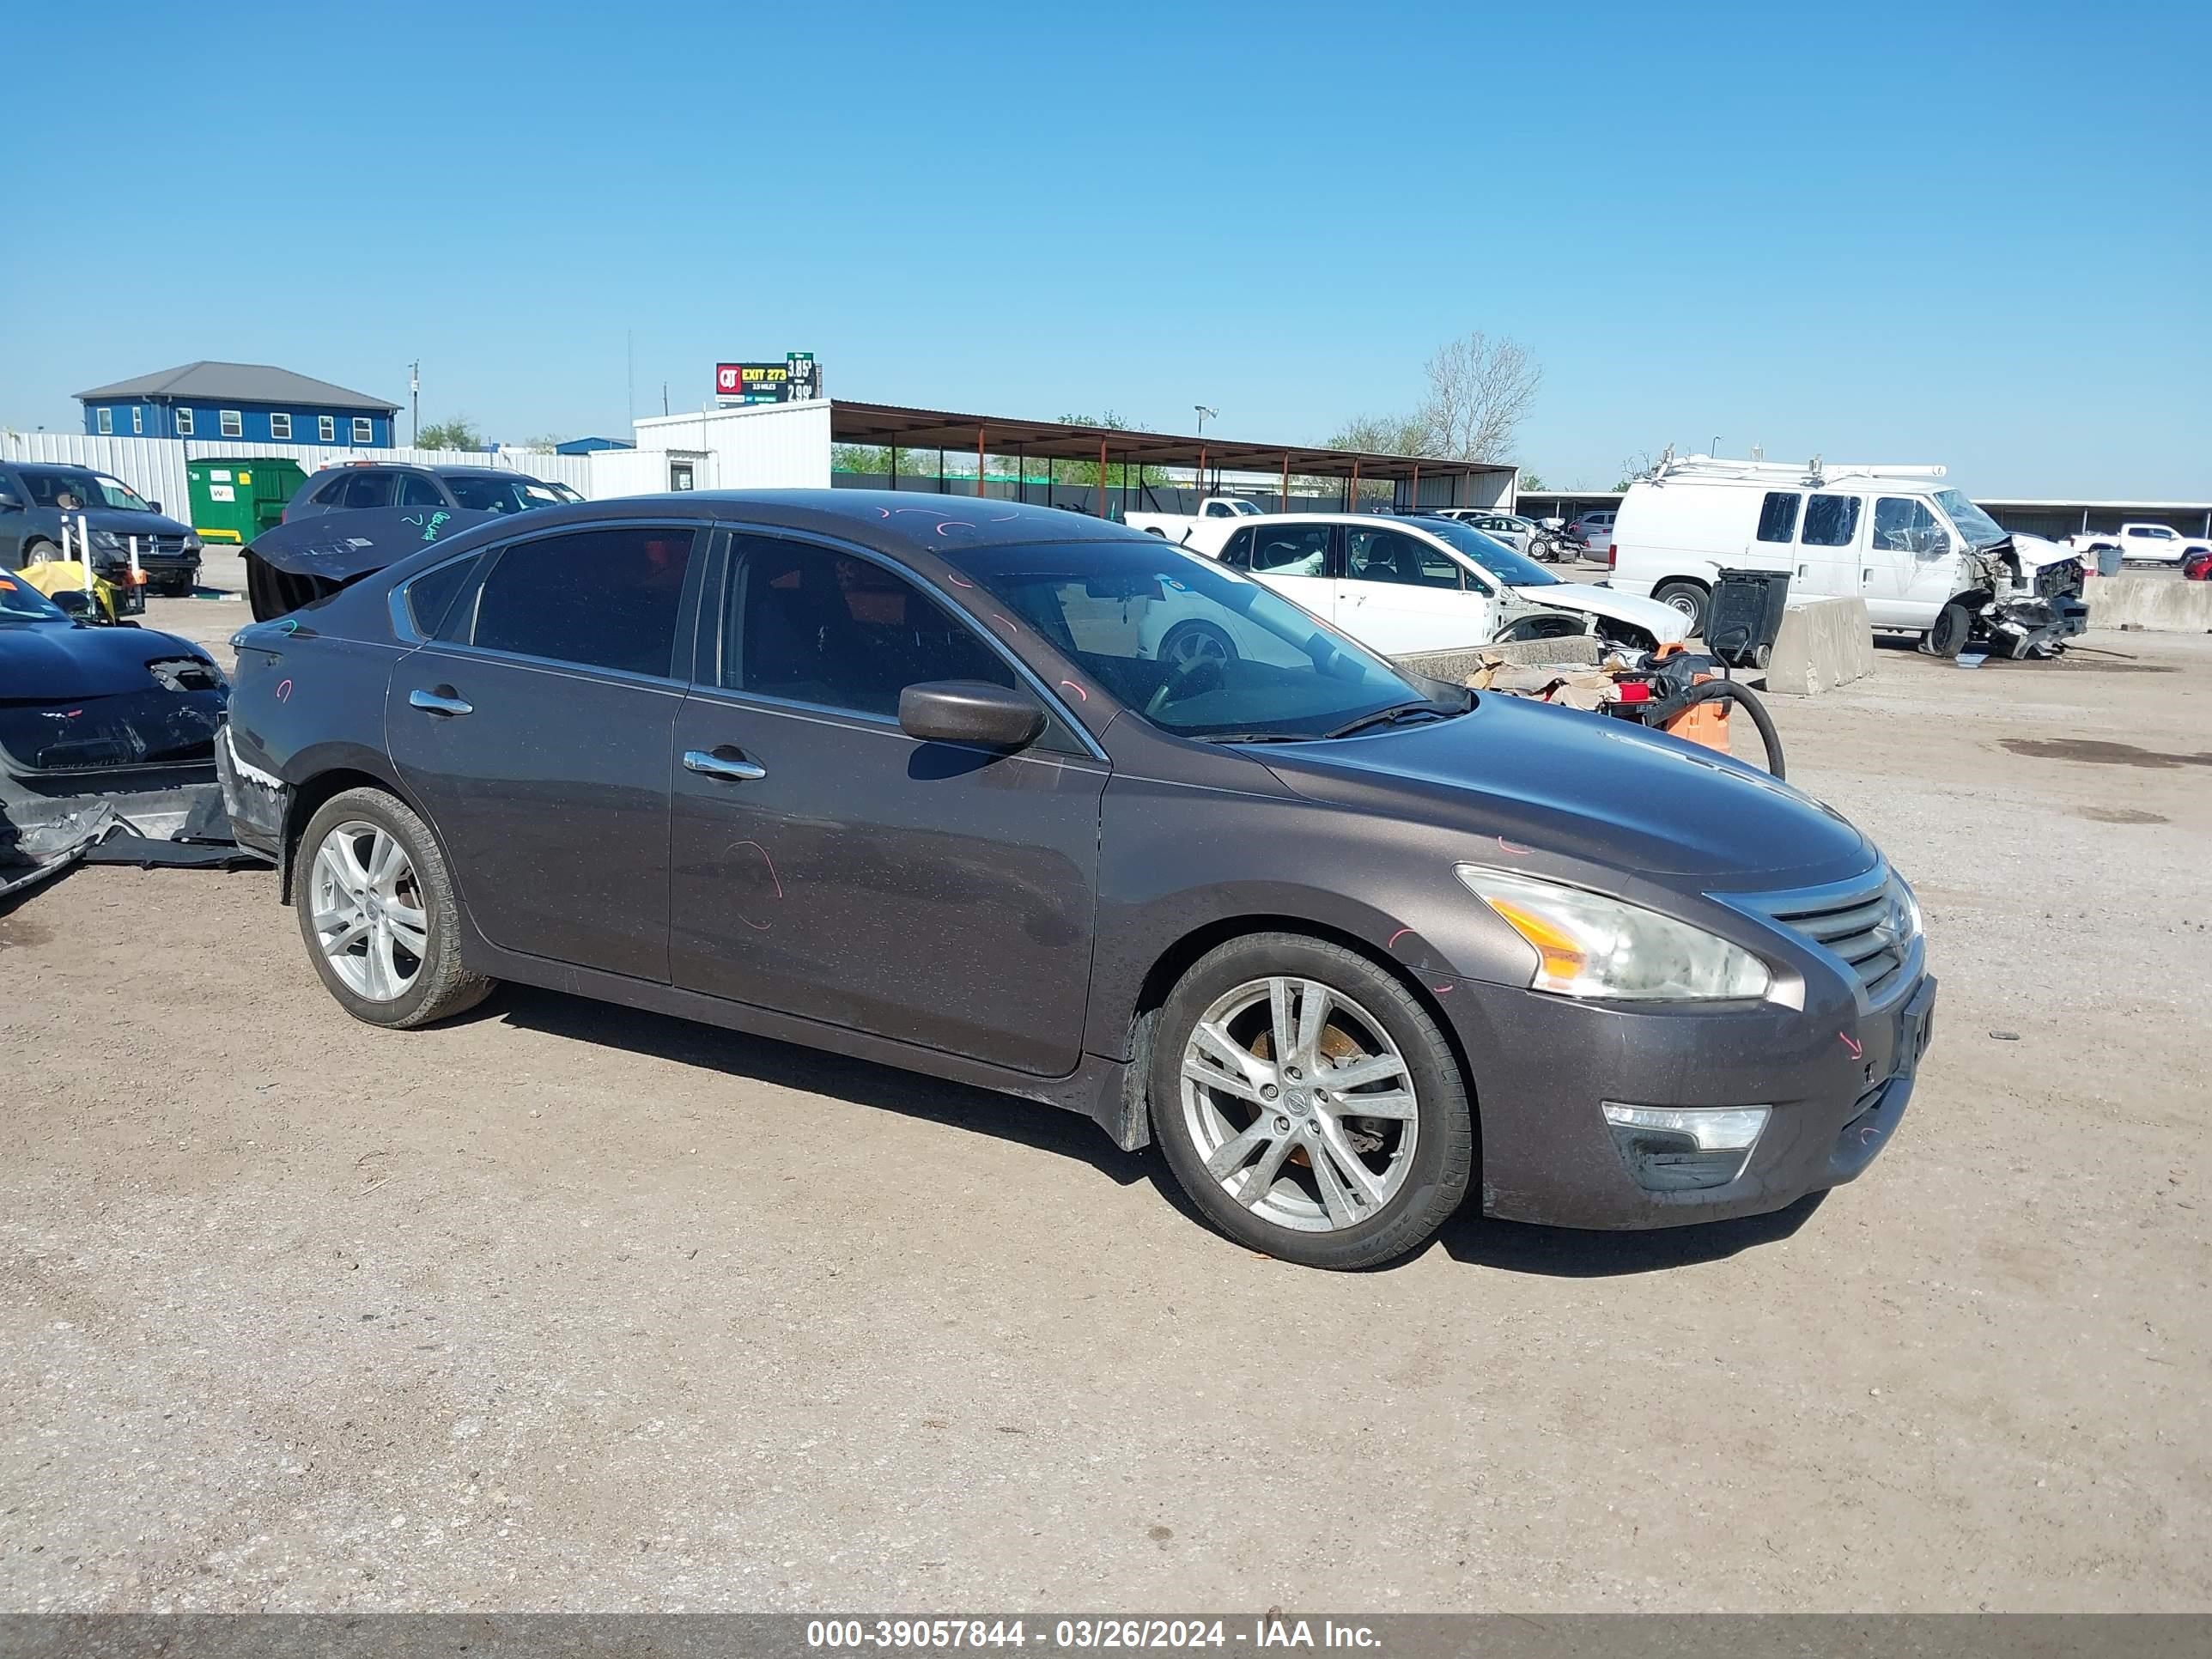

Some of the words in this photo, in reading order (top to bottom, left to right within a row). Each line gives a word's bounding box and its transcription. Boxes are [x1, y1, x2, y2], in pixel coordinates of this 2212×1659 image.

[720, 369, 738, 389] QT
[742, 368, 765, 380] EXIT
[767, 368, 787, 380] 273
